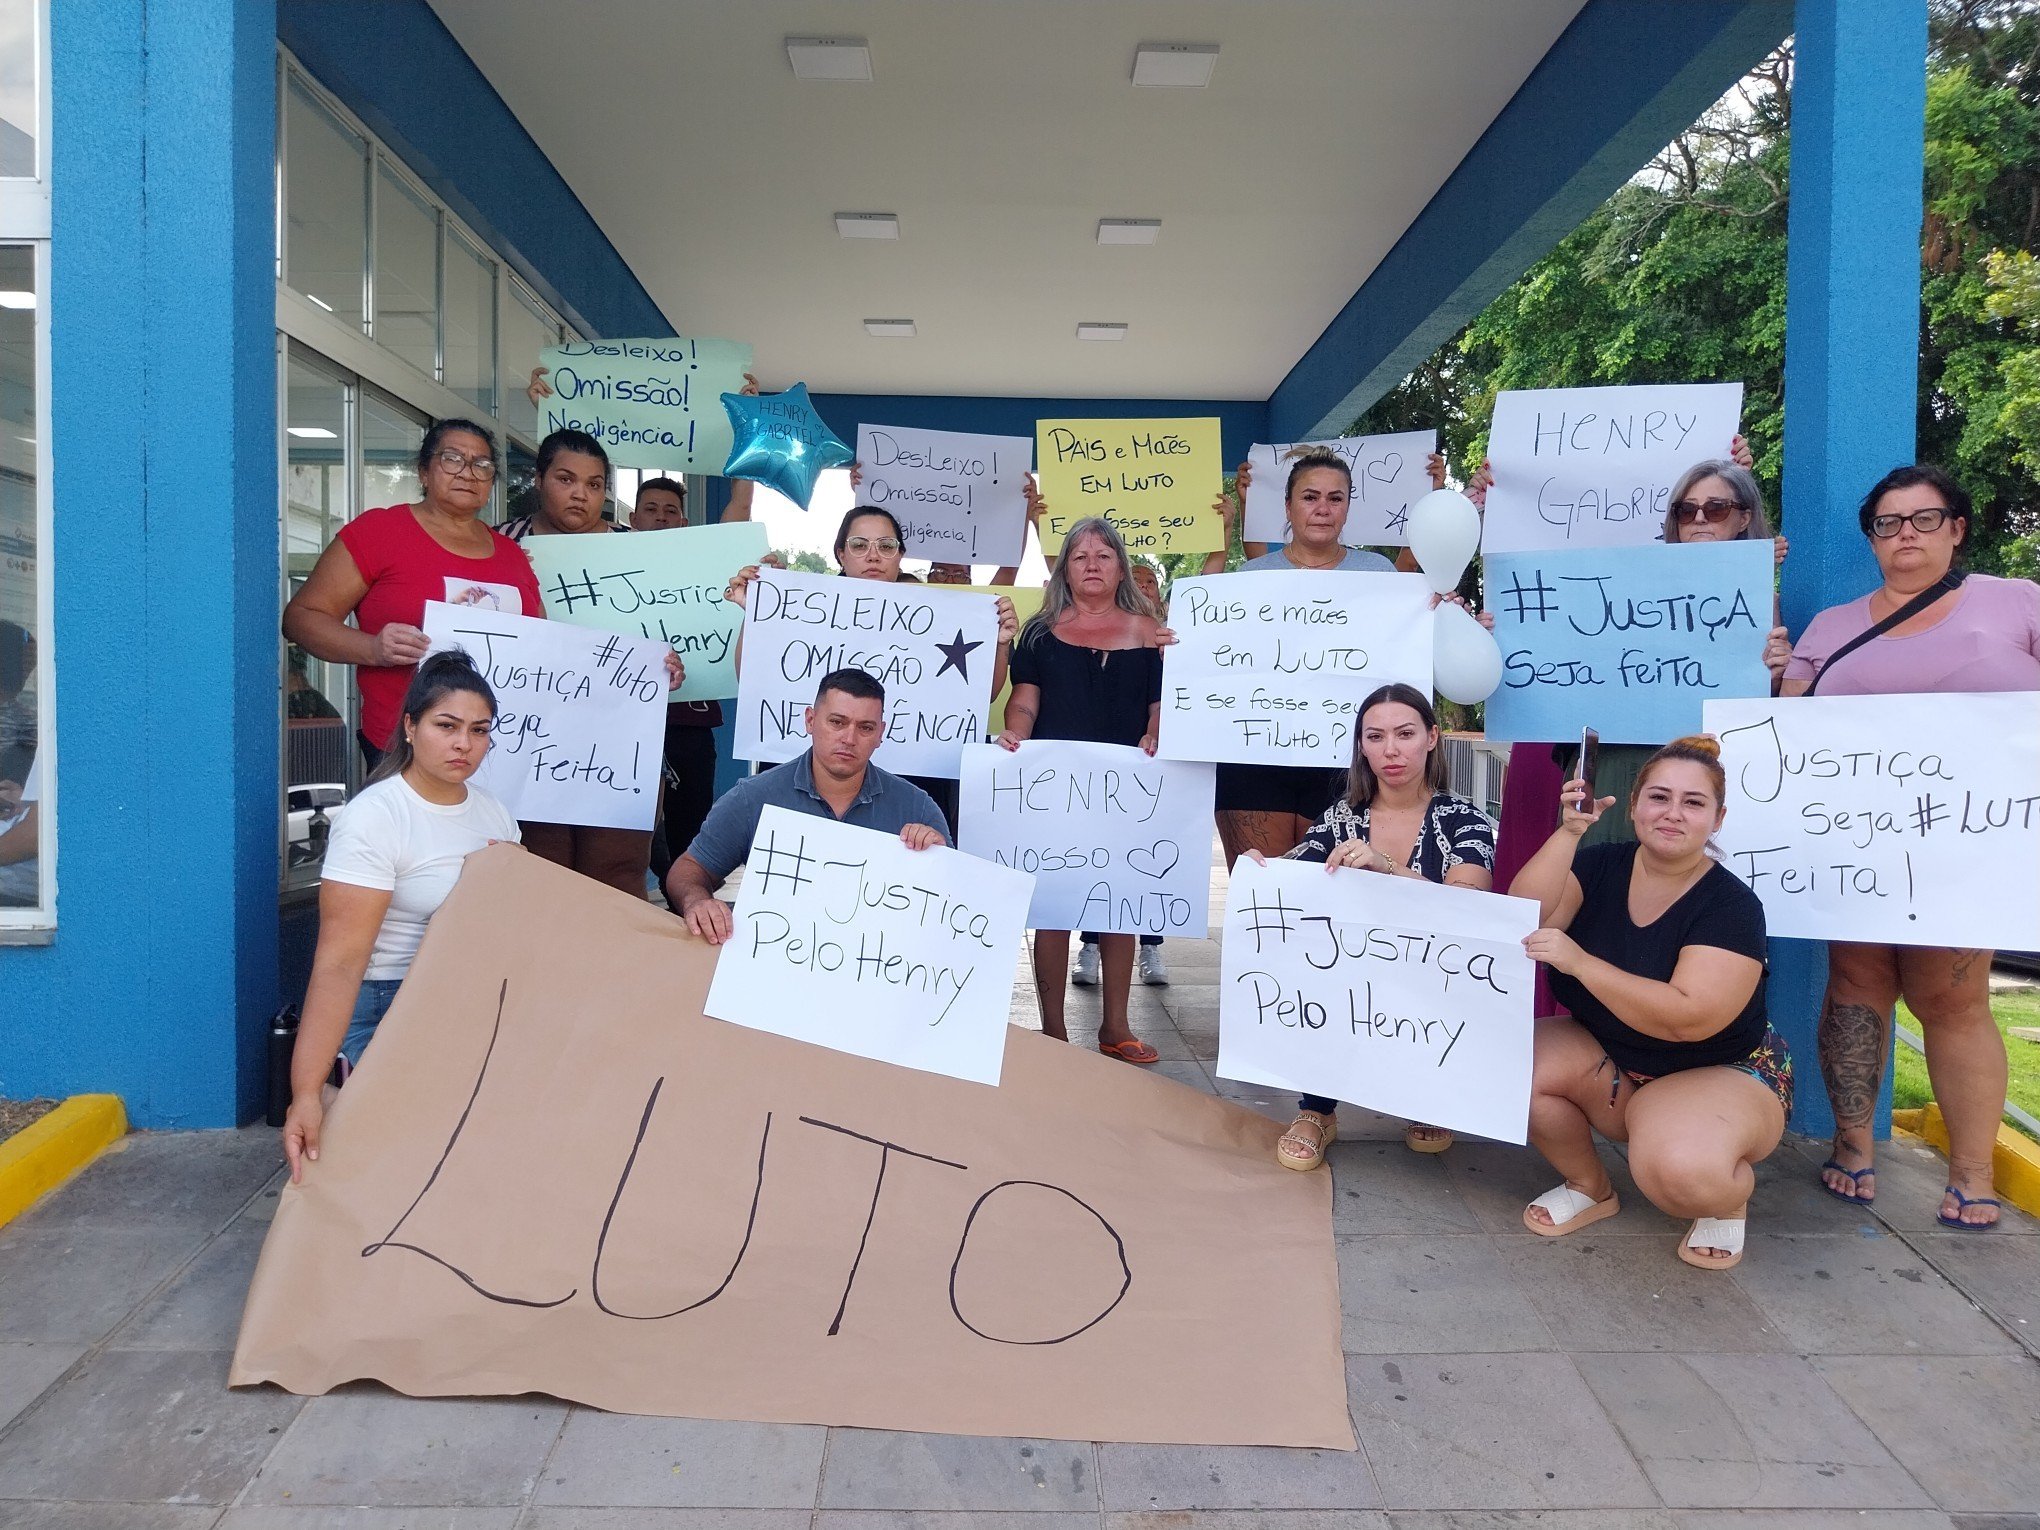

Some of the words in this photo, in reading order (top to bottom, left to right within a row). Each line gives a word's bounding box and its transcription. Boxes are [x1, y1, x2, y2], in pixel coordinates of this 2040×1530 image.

[554, 366, 690, 412] Omissão!
[869, 478, 972, 515] Omissão!
[1081, 477, 1112, 493] EM
[752, 580, 934, 636] DESLEIXO
[1258, 604, 1274, 622] e
[1273, 638, 1369, 674] LUTO
[1174, 687, 1193, 711] E
[855, 930, 974, 1027] Henry
[1348, 980, 1466, 1068] Henry
[361, 978, 1133, 1345] LUTO
